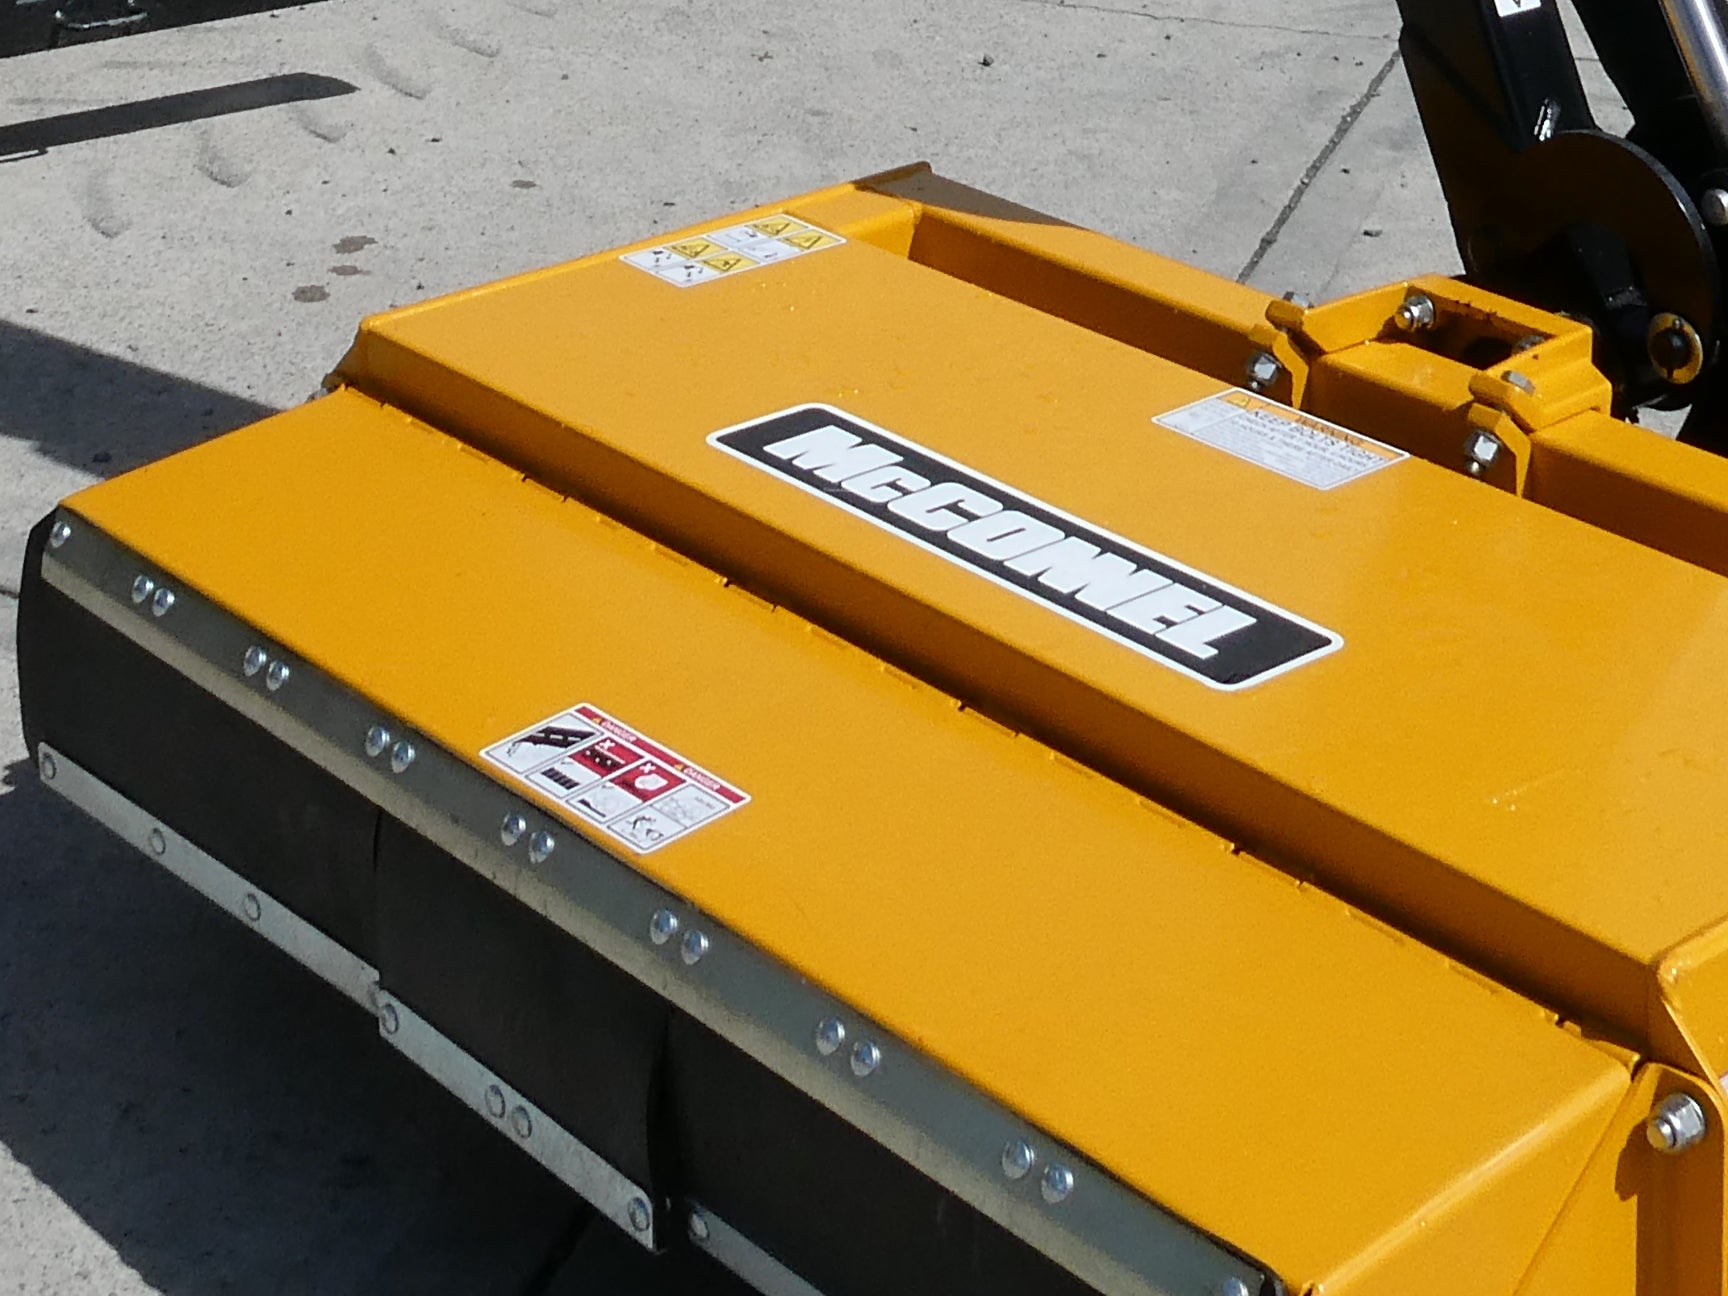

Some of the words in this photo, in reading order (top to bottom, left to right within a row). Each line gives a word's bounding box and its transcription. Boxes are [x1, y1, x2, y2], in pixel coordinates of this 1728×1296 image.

[763, 424, 1257, 660] McCONNEL
[601, 721, 637, 742] DANGER
[684, 768, 721, 790] DANGER
